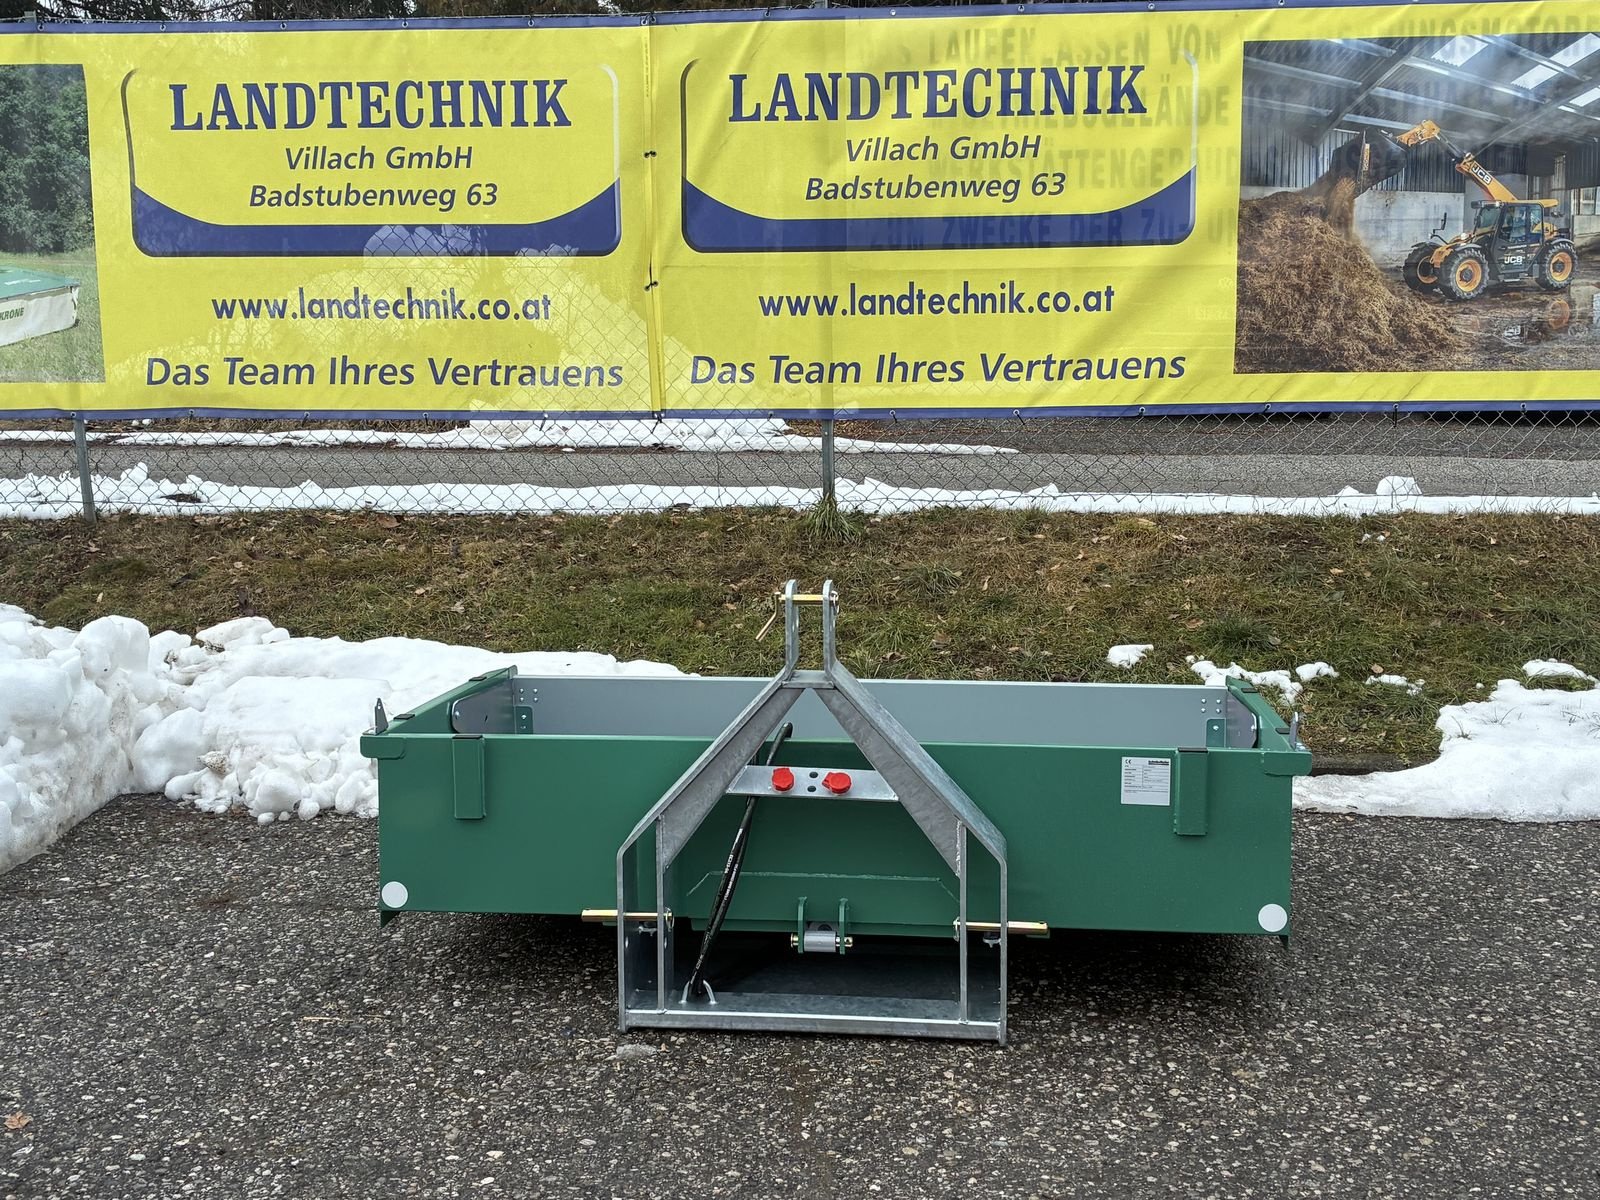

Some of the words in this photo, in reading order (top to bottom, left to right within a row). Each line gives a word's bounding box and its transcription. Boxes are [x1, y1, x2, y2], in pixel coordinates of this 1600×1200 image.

[1166, 23, 1222, 66] VON
[168, 79, 572, 131] LANDTECHNIK
[728, 65, 1148, 123] LANDTECHNIK
[285, 145, 375, 170] Villach
[385, 144, 473, 169] GmbH
[846, 135, 939, 162] Villach
[950, 134, 1042, 160] GmbH
[805, 174, 1021, 203] Badstubenweg
[1031, 172, 1066, 196] 63
[1472, 161, 1492, 185] JCB
[249, 182, 456, 213] Badstubenweg
[466, 182, 498, 206] 63
[1504, 255, 1523, 265] JCB
[0, 307, 25, 321] KRONE
[211, 286, 551, 321] www.landtechnik.co.at
[758, 280, 1115, 317] www.landtechnik.co.at
[146, 357, 209, 386] Das
[223, 357, 315, 386] Team
[329, 355, 415, 386] Ihres
[427, 357, 623, 387] Vertrauens
[690, 355, 755, 384] Das
[769, 355, 861, 384] Team
[875, 352, 965, 383] Ihres
[980, 353, 1186, 382] Vertrauens
